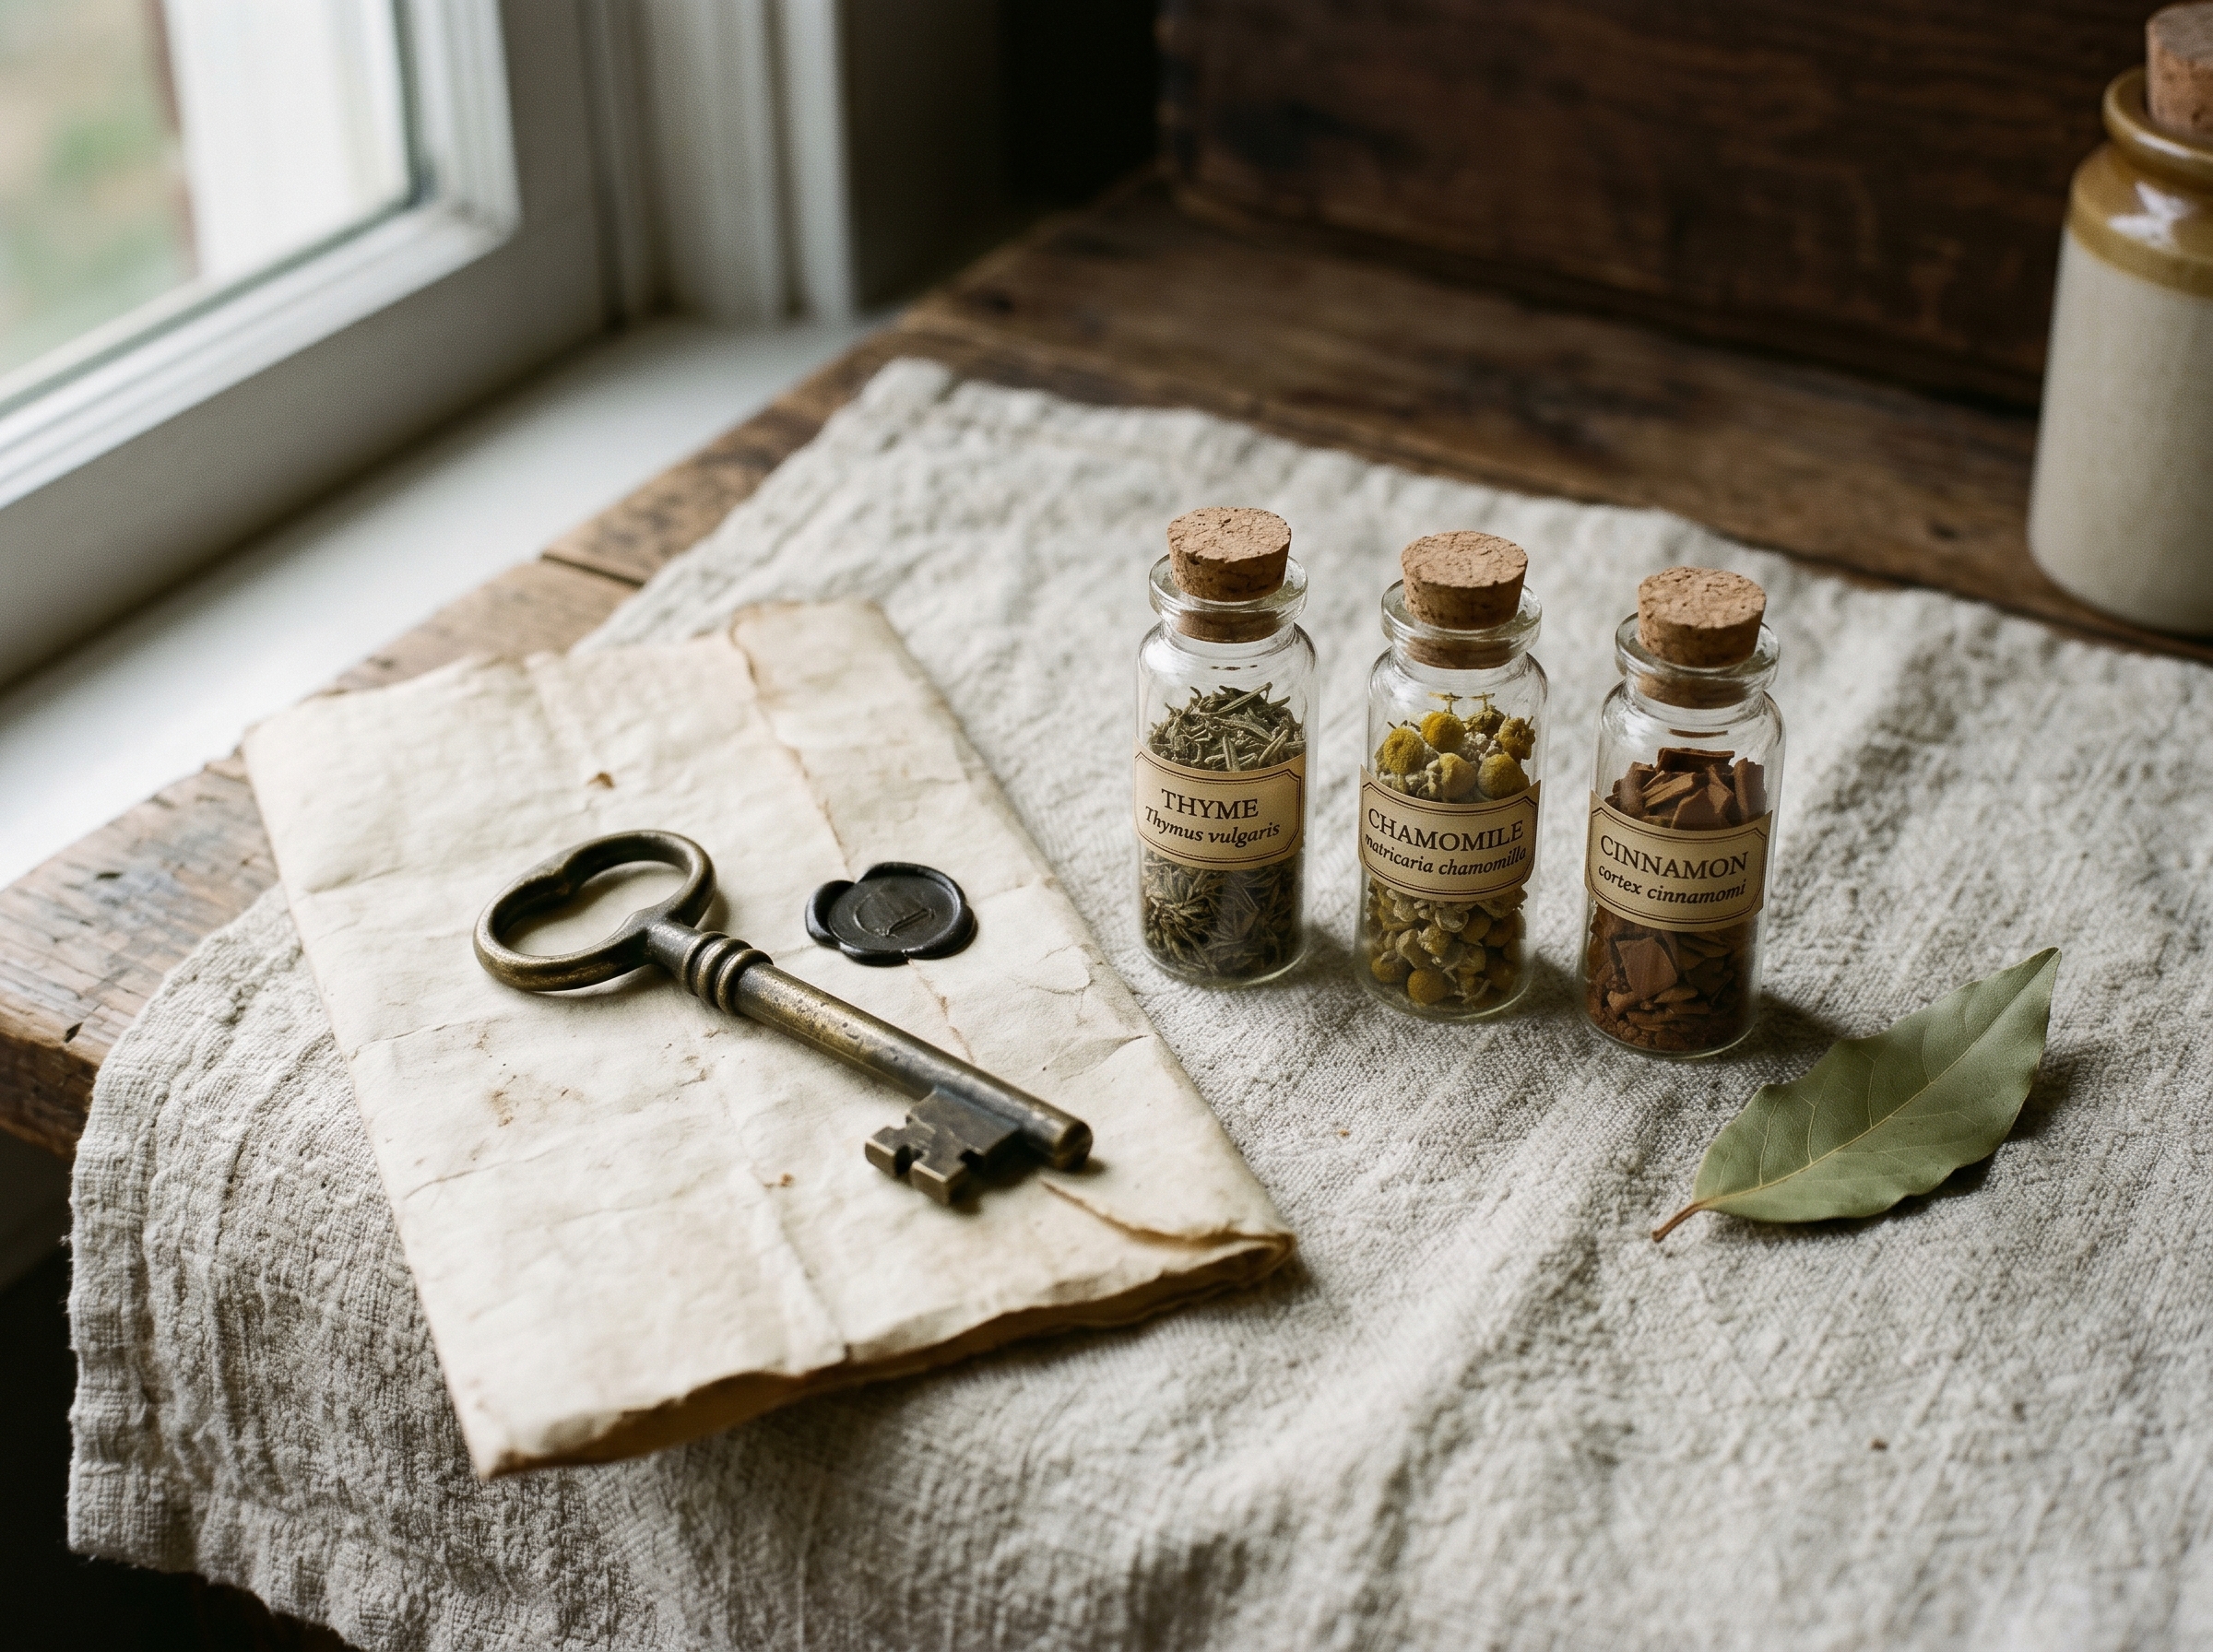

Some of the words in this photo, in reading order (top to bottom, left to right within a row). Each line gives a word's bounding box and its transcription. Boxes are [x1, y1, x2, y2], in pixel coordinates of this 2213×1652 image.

[1161, 788, 1259, 820] THYME
[1145, 806, 1204, 842] Thymus
[1208, 822, 1280, 848] vulgaris
[1368, 808, 1524, 851] CHAMOMILE
[1438, 845, 1527, 876] chamomilla
[1600, 834, 1748, 879] CINNAMON
[1598, 865, 1642, 895] cortex
[1647, 879, 1746, 903] cinnamomi
